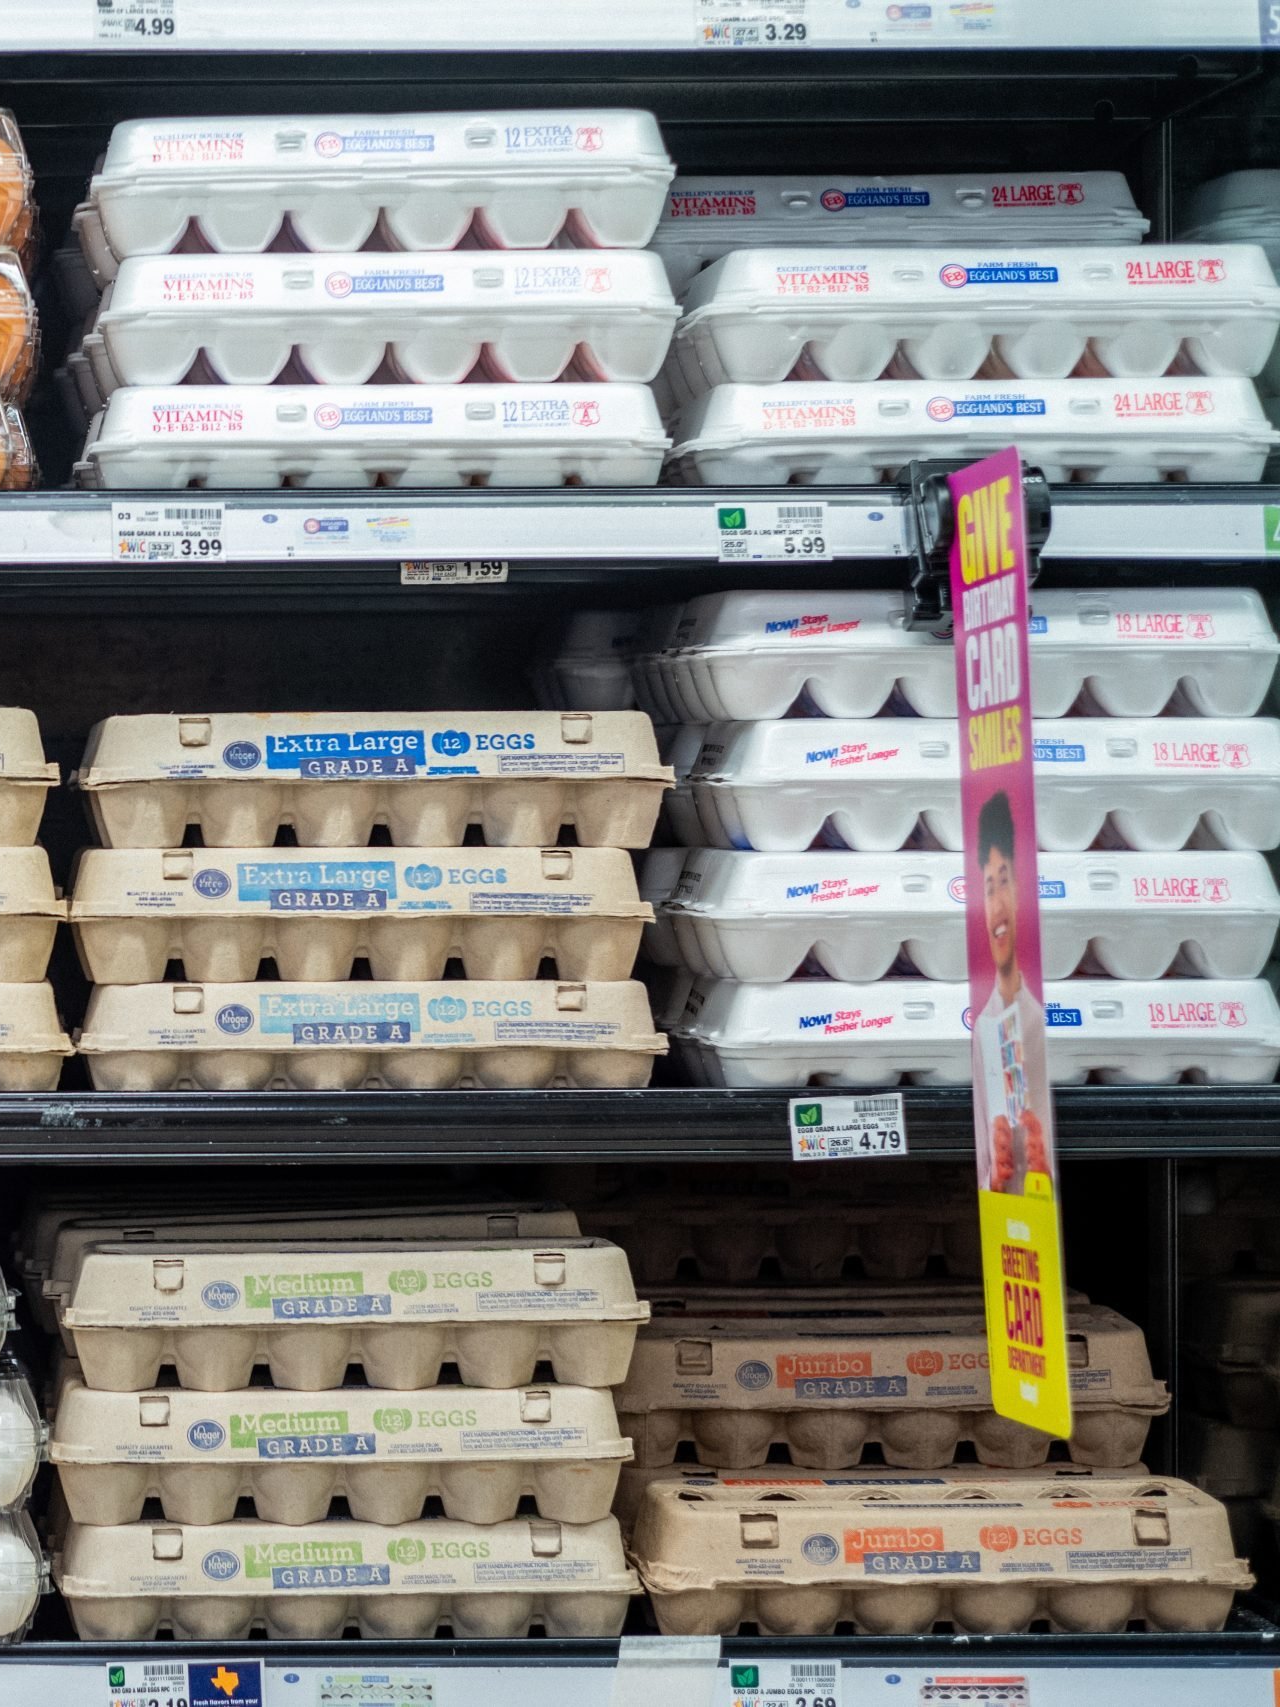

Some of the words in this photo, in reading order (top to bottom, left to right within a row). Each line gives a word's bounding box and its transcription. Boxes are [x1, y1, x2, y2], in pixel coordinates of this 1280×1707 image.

[134, 18, 175, 35] 4.99
[765, 23, 807, 41] 3.29
[992, 186, 1008, 202] 24
[1010, 185, 1055, 201] LARGE
[671, 197, 757, 209] VITAMINS
[776, 272, 869, 284] VITAMINS
[1028, 269, 1055, 280] BEST
[1125, 262, 1143, 279] 24
[1147, 261, 1195, 278] LARGE
[1015, 402, 1042, 413] BEST
[1114, 394, 1131, 411] 24
[1135, 392, 1183, 410] LARGE
[153, 410, 244, 423] VITAMINS
[404, 410, 431, 420] BEST
[502, 401, 517, 422] 12
[521, 400, 569, 411] EXTRA
[521, 411, 569, 421] LARGE
[957, 475, 1016, 585] GIVE
[181, 539, 222, 556] 3.99
[784, 537, 826, 554] 5.99
[463, 561, 503, 576] 1.59
[765, 618, 799, 634] NOW!
[790, 624, 824, 638] Fresher
[827, 618, 861, 633] Longer
[800, 614, 829, 625] Stays
[965, 621, 1020, 712] CARD
[272, 735, 341, 753] Extra
[348, 732, 418, 753] Large
[442, 737, 460, 749] 12
[476, 733, 535, 750] EGGS
[969, 705, 1022, 770] SMILES
[229, 745, 256, 762] Kroger
[805, 747, 839, 764] NOW!
[830, 754, 863, 767] Fresher
[866, 747, 900, 762] Longer
[840, 743, 868, 755] Stays
[1153, 742, 1169, 761] 18
[1172, 743, 1220, 762] LARGE
[308, 758, 383, 773] GRADE
[395, 757, 409, 772] A
[834, 1009, 862, 1021] Stays
[1148, 1002, 1164, 1022] 18
[1169, 1002, 1217, 1022] LARGE
[799, 1013, 832, 1029] NOW!
[824, 1021, 858, 1035] Fresher
[861, 1015, 895, 1029] Longer
[859, 1131, 901, 1150] 4.79
[253, 1274, 357, 1296] Medium
[398, 1277, 417, 1288] 12
[432, 1271, 493, 1288] EGGS
[208, 1287, 235, 1305] Kroger
[281, 1297, 359, 1315] GRADE
[370, 1297, 384, 1312] A
[1003, 1280, 1044, 1349] CARD
[784, 1353, 864, 1376] Jumbo
[803, 1381, 881, 1395] GRADE
[888, 1380, 901, 1393] A
[852, 1529, 935, 1551] Jumbo
[989, 1532, 1009, 1544] 12
[1023, 1528, 1083, 1546] EGGS
[255, 1542, 355, 1563] Medium
[398, 1545, 416, 1556] 12
[431, 1542, 490, 1559] EGGS
[808, 1540, 835, 1557] Kroger
[208, 1557, 235, 1574] Kroger
[872, 1556, 946, 1571] GRADE
[960, 1555, 973, 1569] A
[281, 1568, 357, 1586] GRADE
[370, 1566, 383, 1582] A
